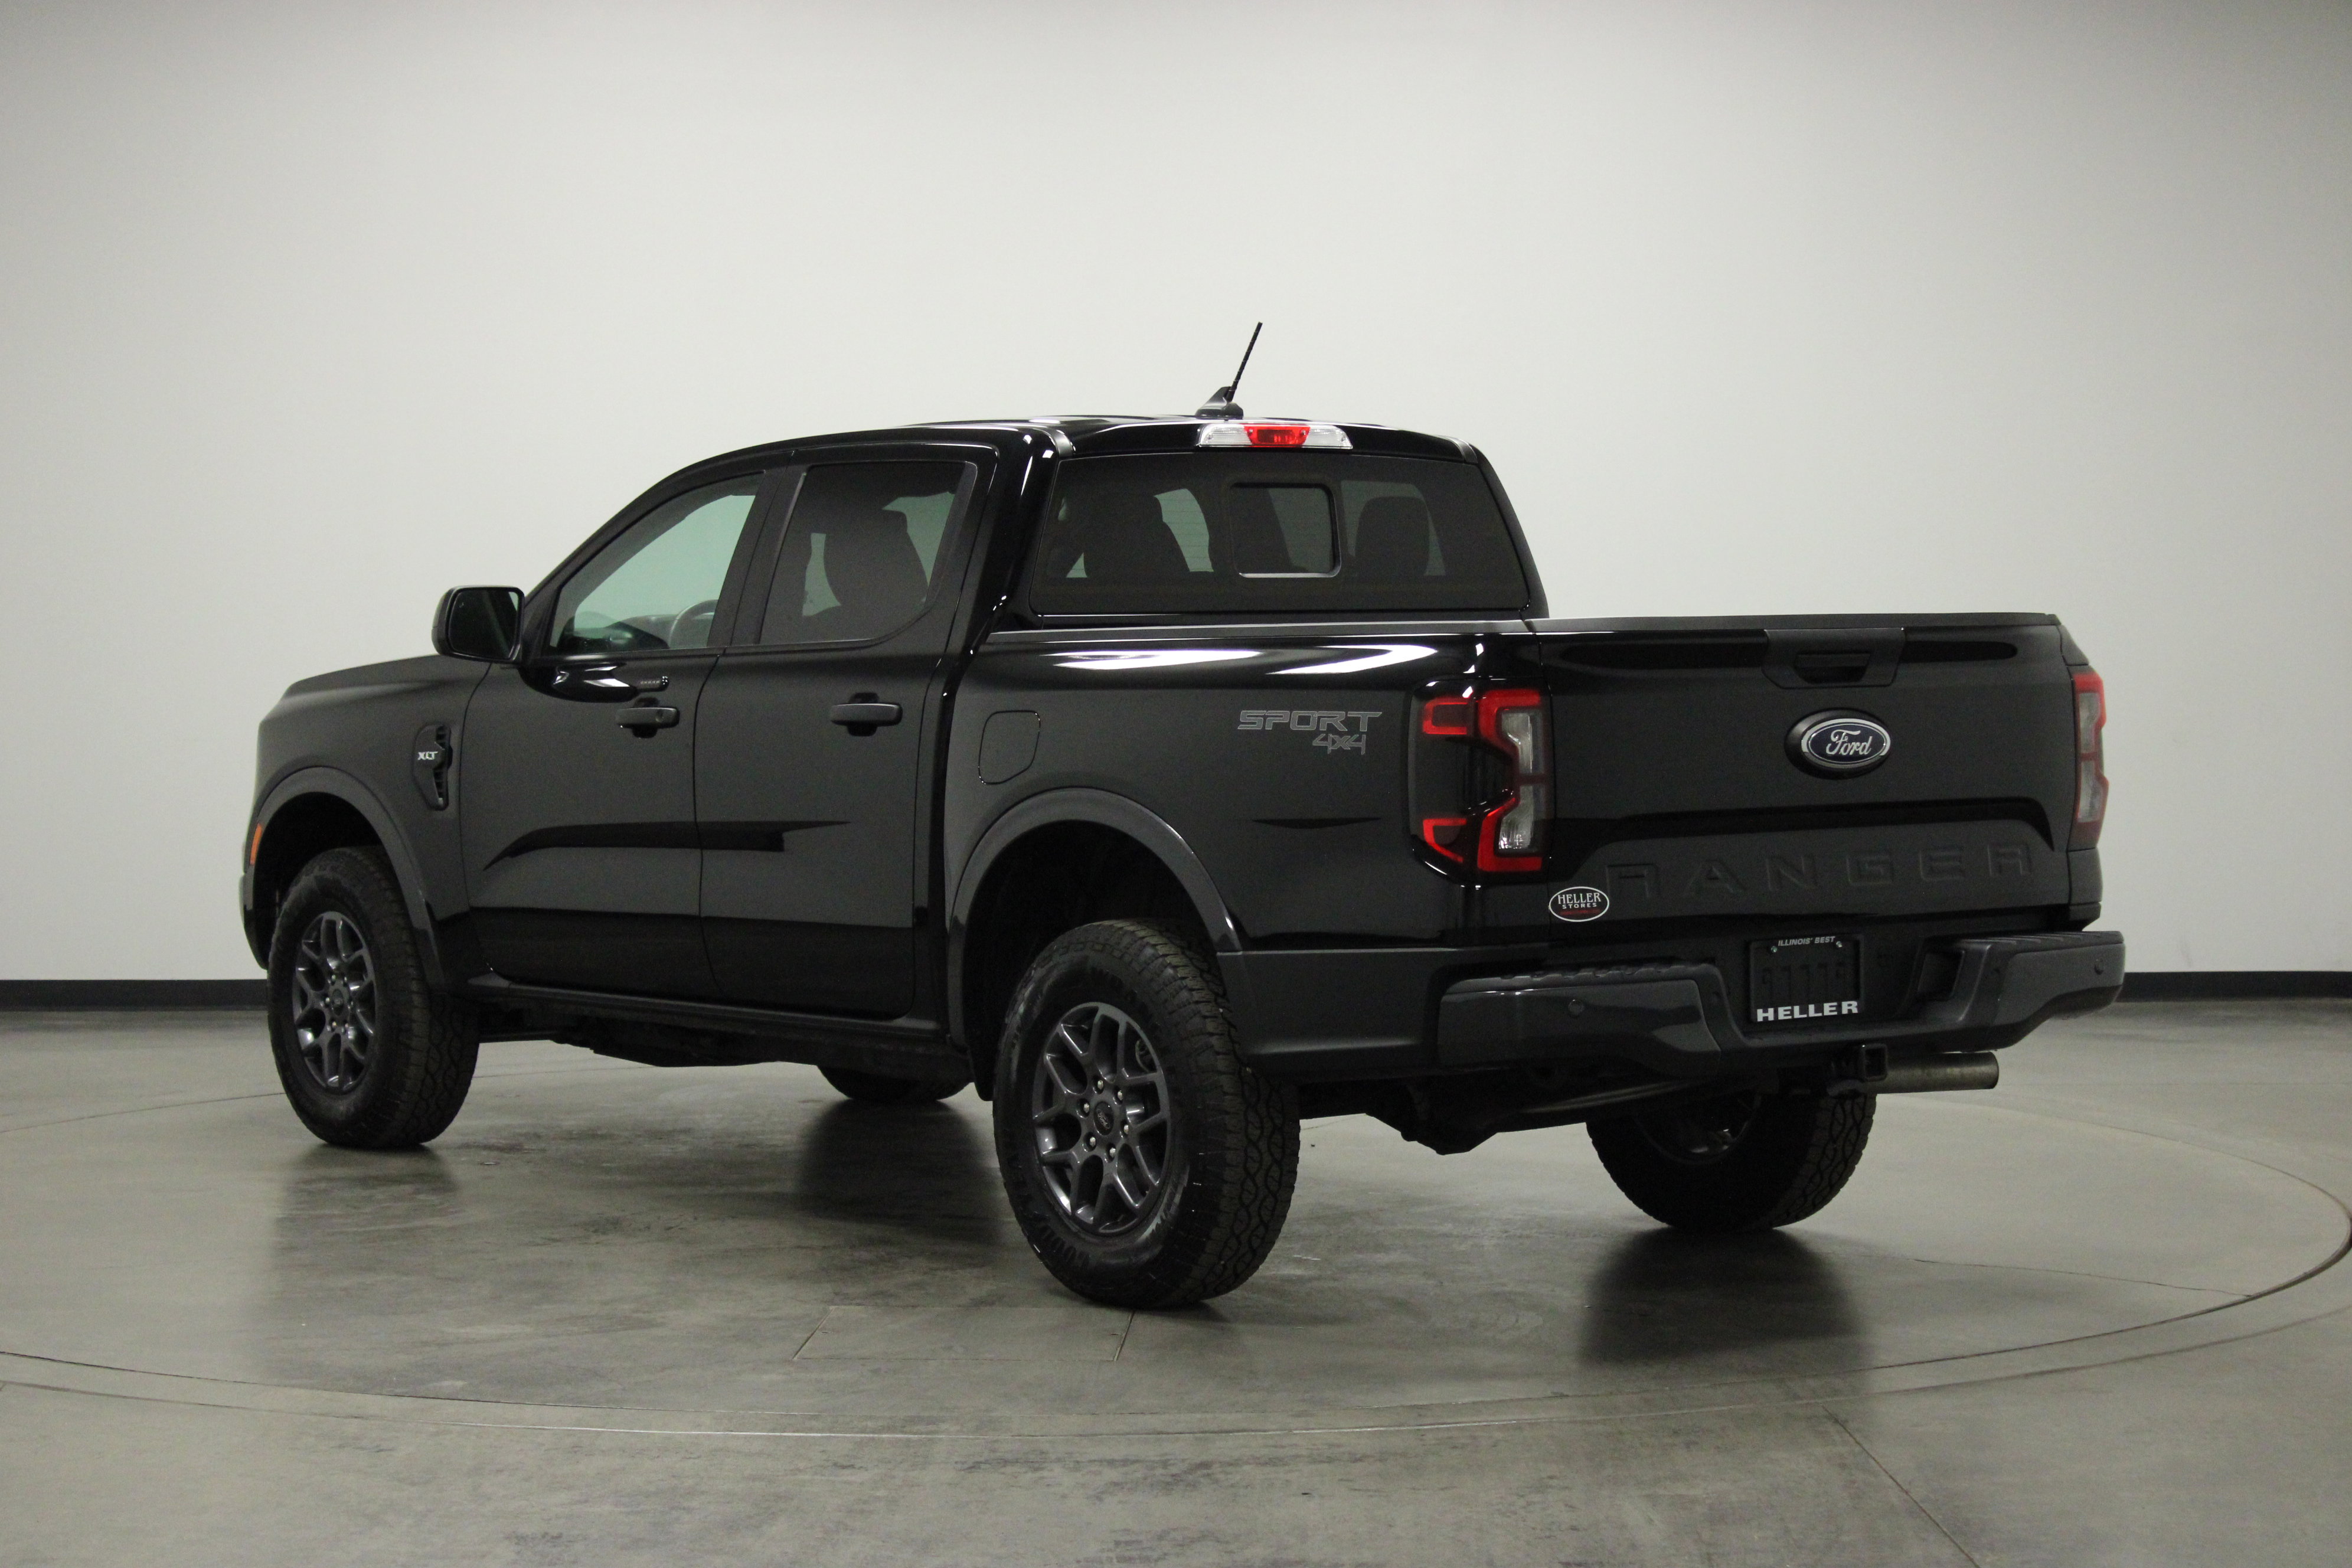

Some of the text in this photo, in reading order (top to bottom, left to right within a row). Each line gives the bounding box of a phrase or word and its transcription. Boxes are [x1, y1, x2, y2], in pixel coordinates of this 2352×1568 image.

[1237, 710, 1383, 732] SPORT
[1825, 729, 1873, 756] Ford
[417, 751, 439, 761] XLT
[1604, 842, 2033, 899] RANGER
[1557, 892, 1602, 904] HELLER
[1814, 936, 1836, 944] BEST
[1756, 1001, 1859, 1023] HELLER
